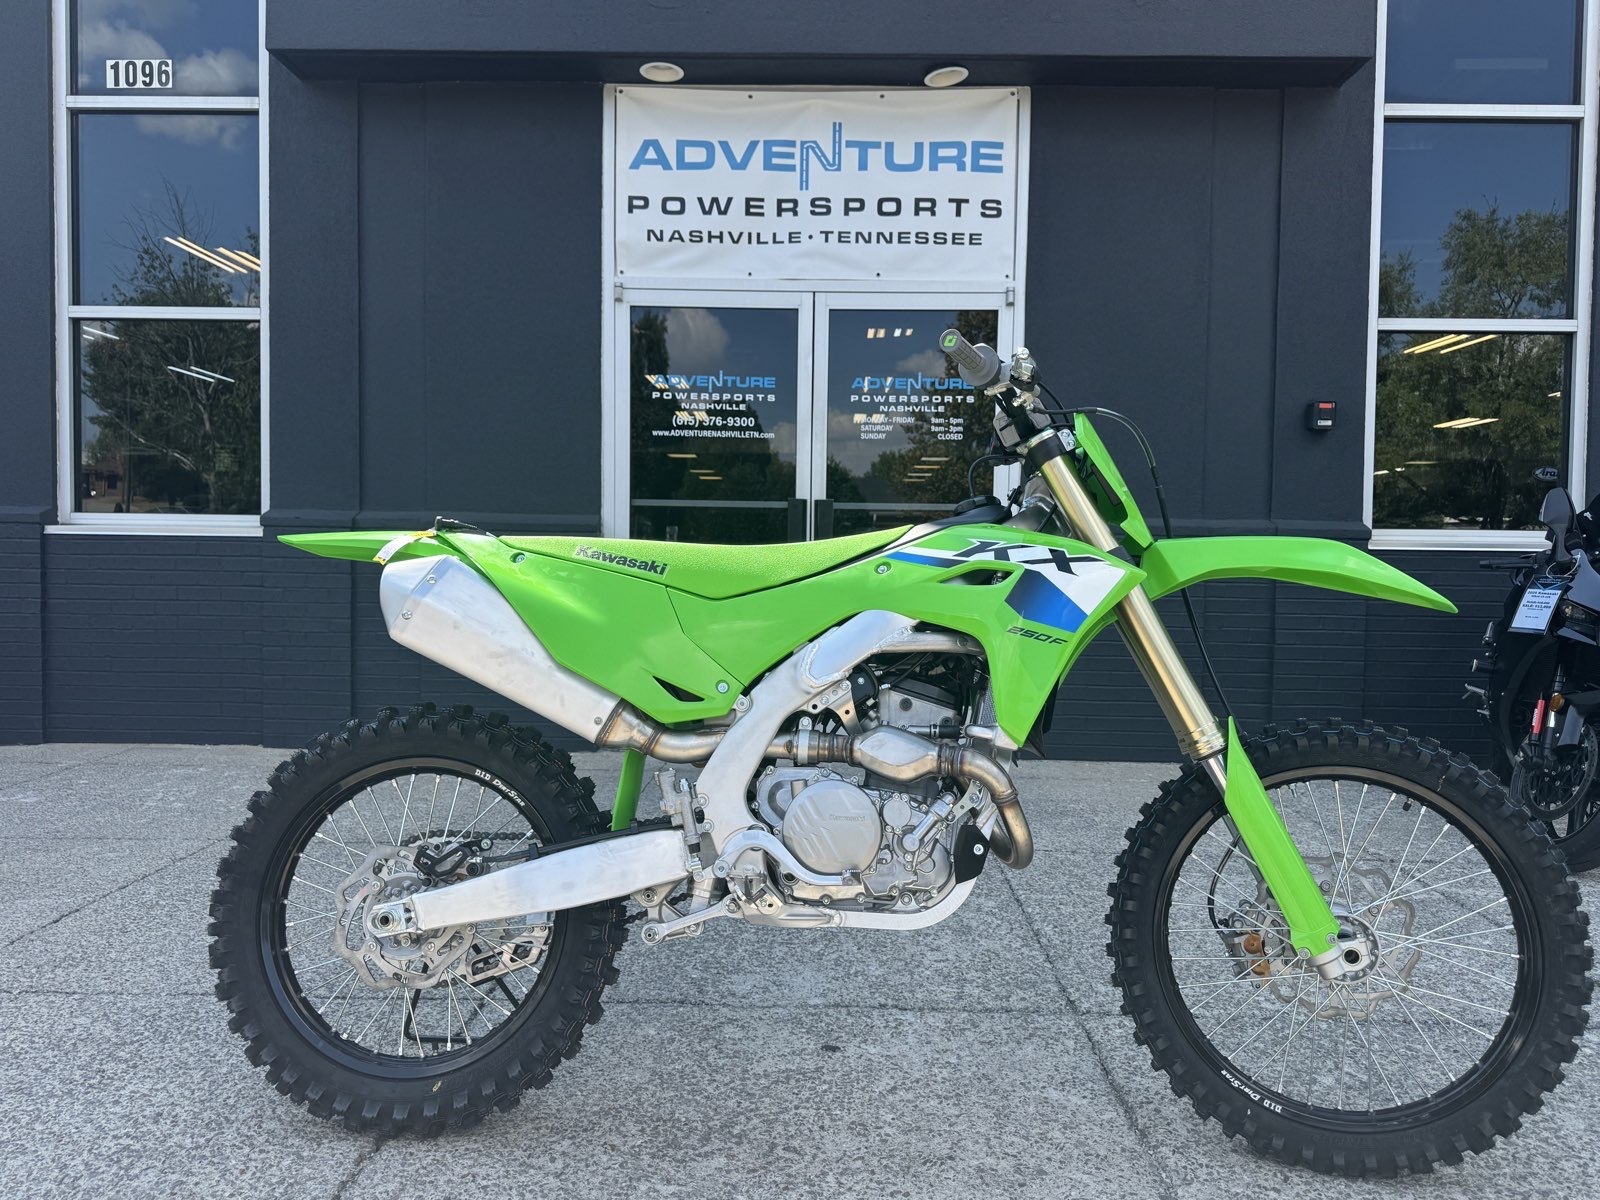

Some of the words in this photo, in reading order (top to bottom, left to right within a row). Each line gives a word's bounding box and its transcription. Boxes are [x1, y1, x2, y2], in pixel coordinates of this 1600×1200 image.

[110, 60, 170, 87] 1096
[628, 121, 1004, 191] ADVENTURE
[627, 195, 1003, 218] POWERSPORTS
[646, 228, 802, 244] NASHVILLE
[819, 230, 983, 246] TENNESSEE
[652, 370, 776, 392] ADVENTURE
[851, 372, 975, 395] ADVENTURE
[652, 391, 776, 402] POWERSPORTS
[850, 395, 975, 403] POWERSPORTS
[681, 402, 747, 411] NASHVILLE
[879, 405, 945, 413] NASHVILLE
[652, 429, 776, 439] www.ADVENTURENASHVILLETN.com
[937, 433, 964, 441] CLOSED
[575, 545, 668, 575] Kawasaki
[952, 539, 1104, 577] KX
[1005, 626, 1069, 645] 250F
[475, 768, 491, 781] DID
[1263, 1099, 1283, 1113] DID
